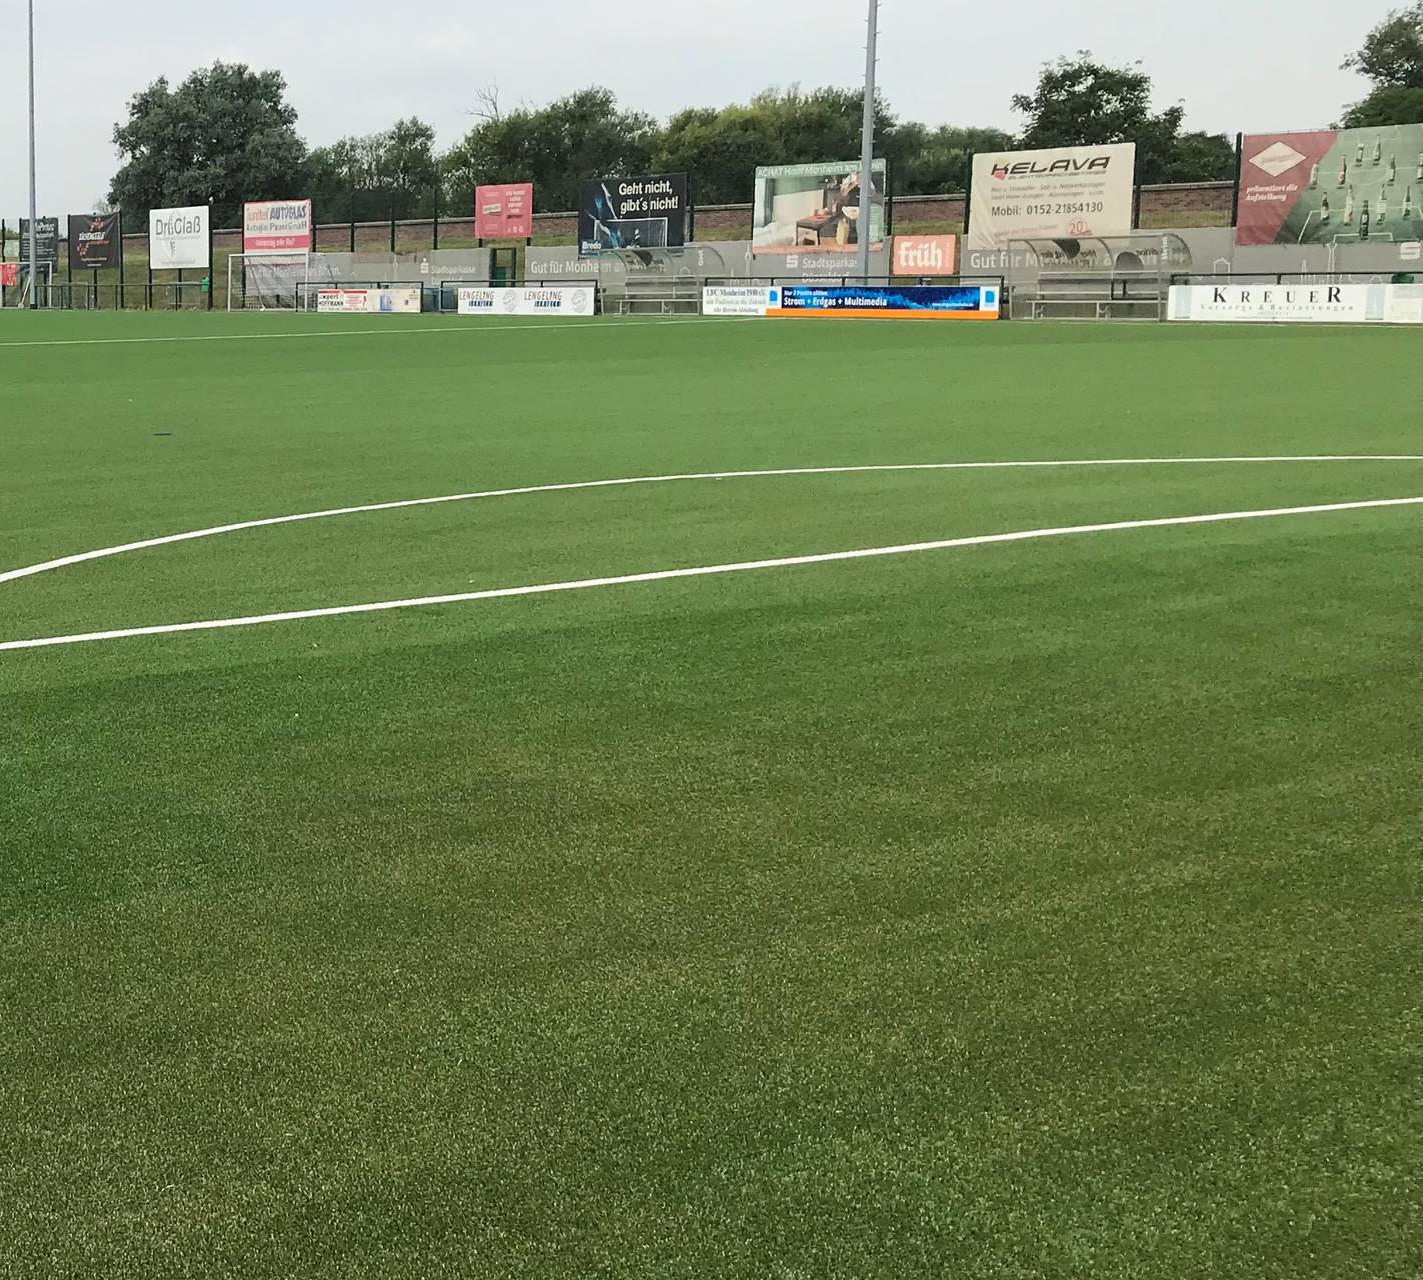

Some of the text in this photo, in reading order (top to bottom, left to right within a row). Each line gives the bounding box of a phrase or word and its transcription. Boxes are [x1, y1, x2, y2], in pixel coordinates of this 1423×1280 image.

[991, 156, 1111, 176] KELAVA
[619, 180, 673, 196] Geht nicht,
[1286, 183, 1298, 191] die
[650, 196, 679, 211] nicht!
[1245, 193, 1287, 202] Aufstellung
[270, 205, 307, 220] AUTOGLAS
[991, 204, 1021, 217] Mobil:
[174, 215, 201, 235] Glaß
[898, 240, 943, 270] früh
[970, 252, 997, 269] Gut
[531, 261, 547, 274] Gut
[549, 261, 563, 274] für
[459, 291, 494, 300] LENGELING
[524, 291, 562, 301] LENGELING
[784, 297, 805, 306] Strom
[812, 297, 836, 307] Erdgas
[844, 297, 888, 307] Multimedia
[1213, 286, 1341, 303] KREUER
